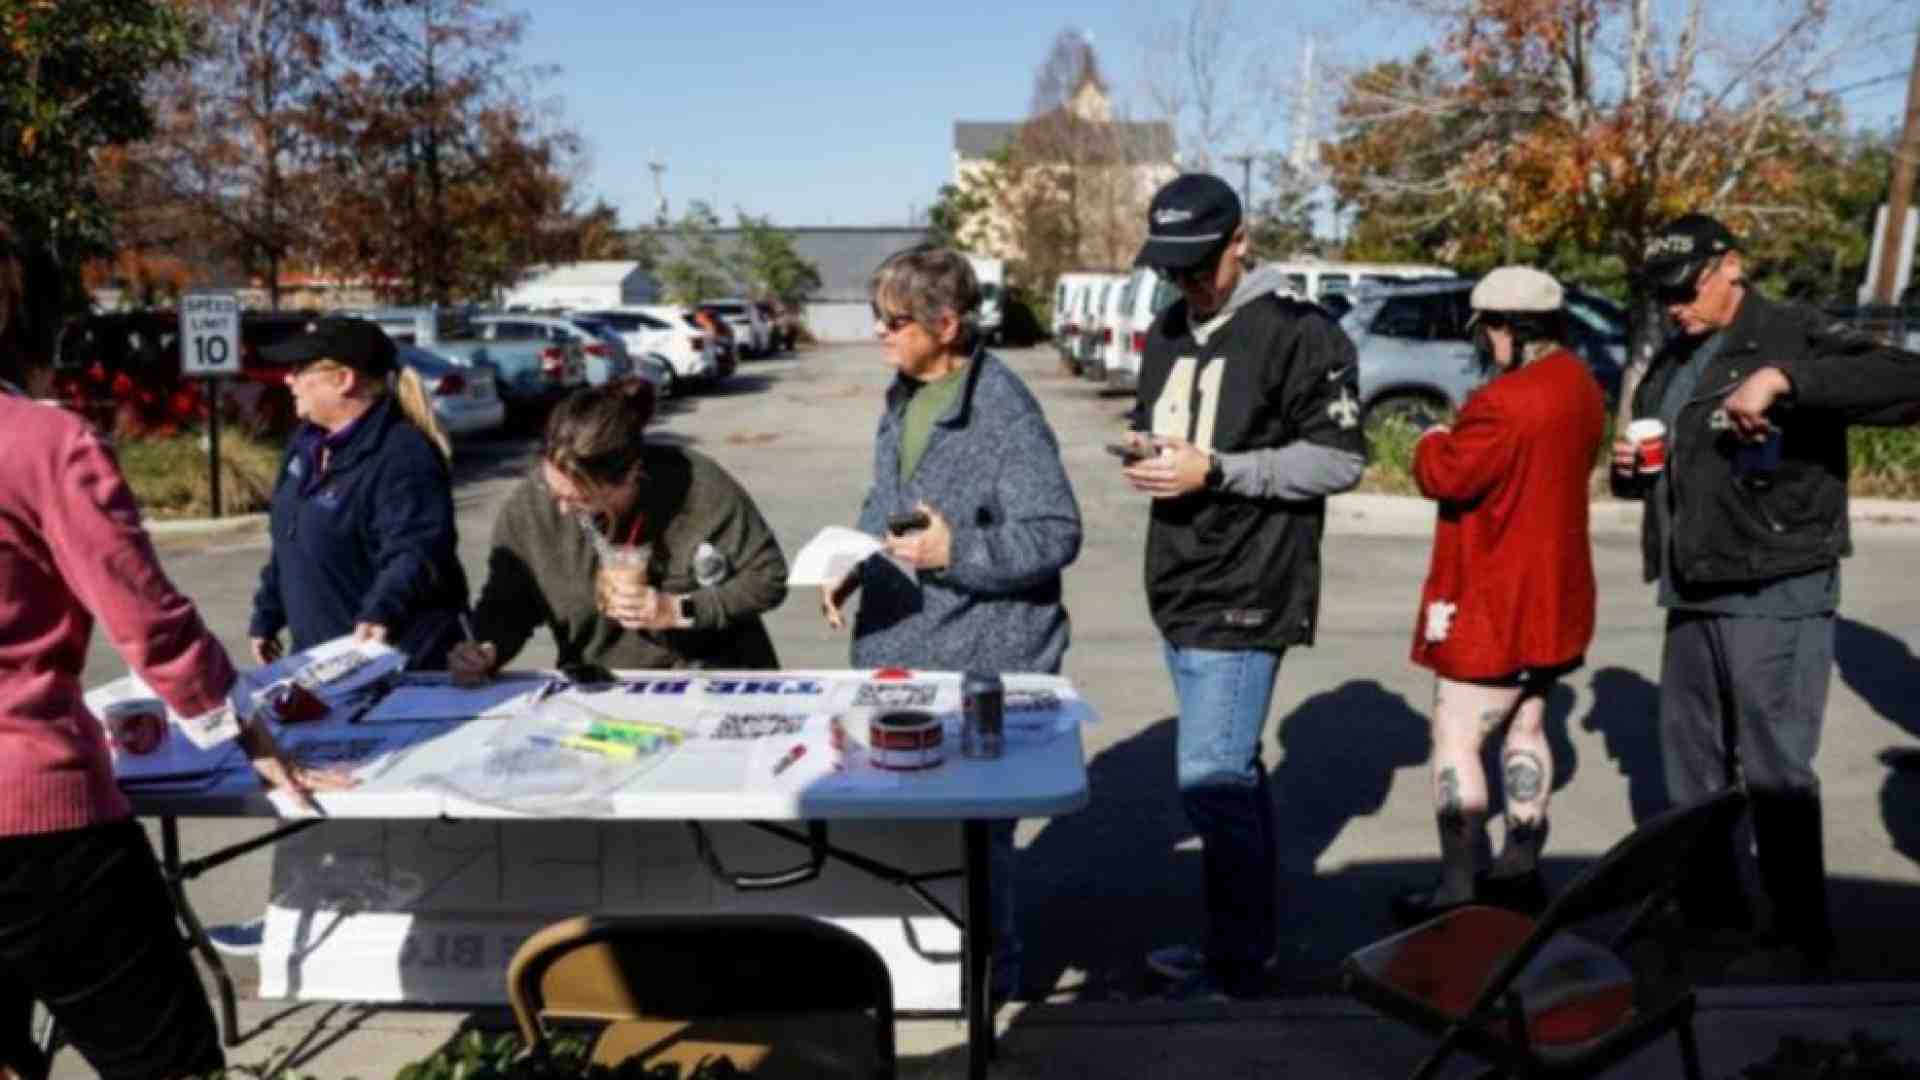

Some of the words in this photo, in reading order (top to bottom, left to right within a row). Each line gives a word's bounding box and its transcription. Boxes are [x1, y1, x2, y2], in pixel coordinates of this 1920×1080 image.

[185, 300, 236, 313] SPEED
[191, 317, 228, 330] LIMIT
[194, 335, 229, 365] 10
[1151, 357, 1227, 450] 41
[704, 680, 823, 696] THE
